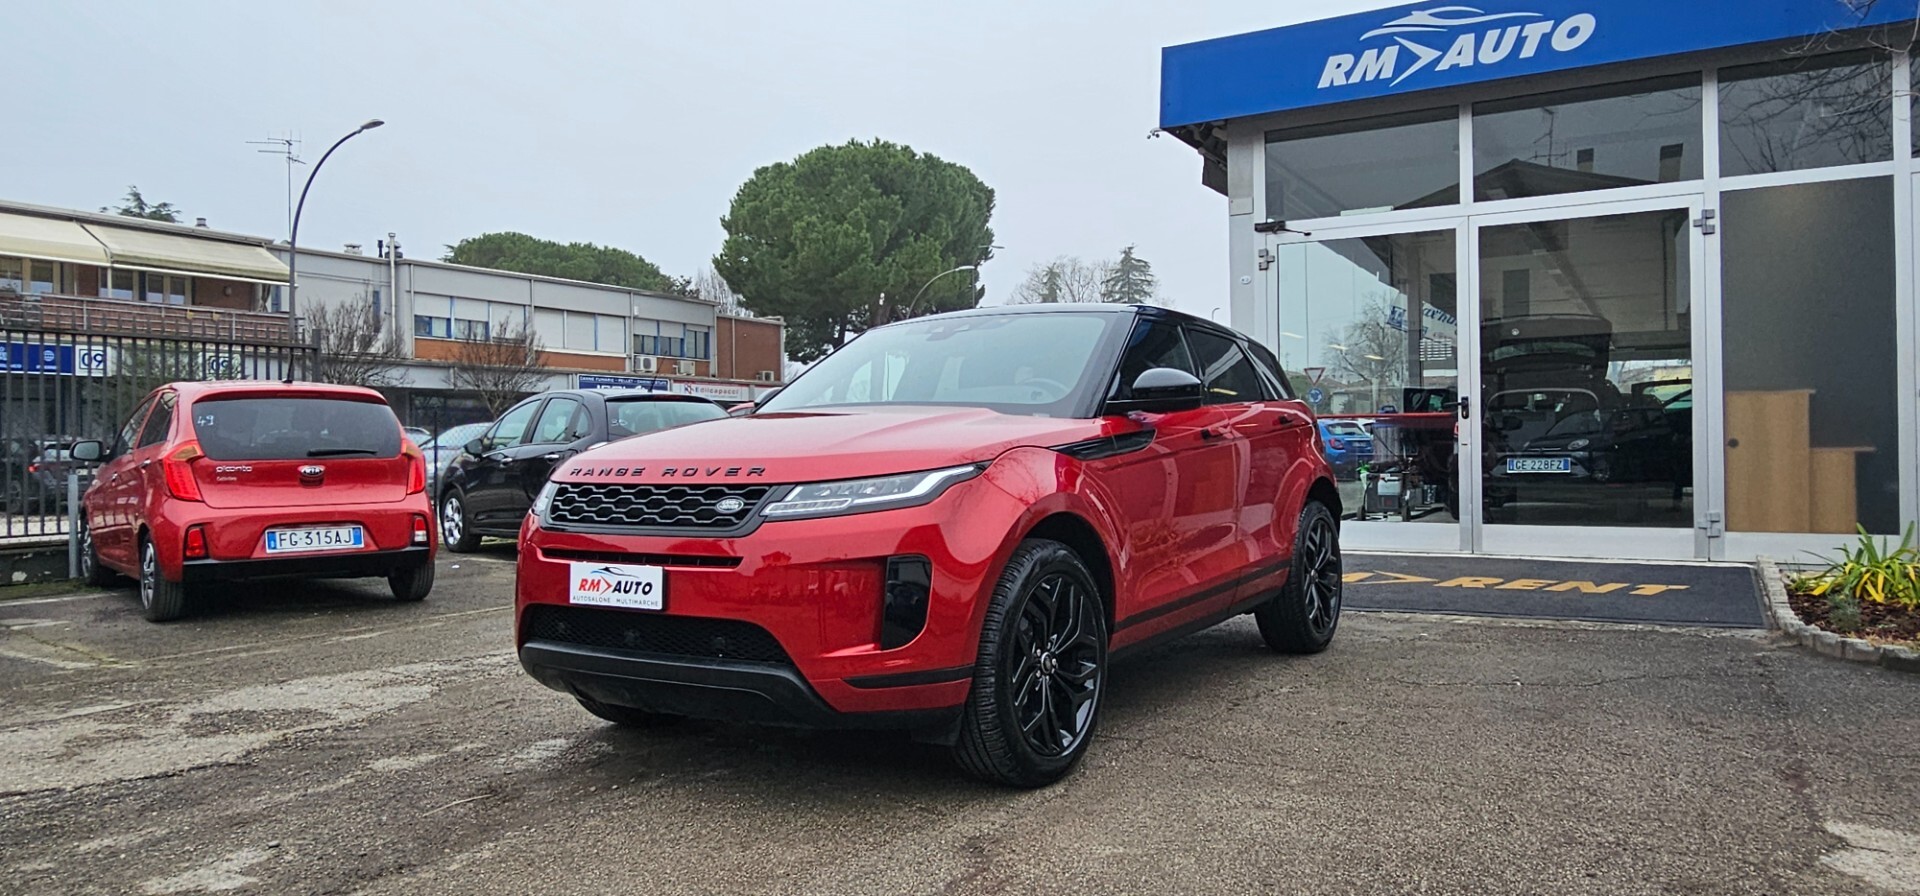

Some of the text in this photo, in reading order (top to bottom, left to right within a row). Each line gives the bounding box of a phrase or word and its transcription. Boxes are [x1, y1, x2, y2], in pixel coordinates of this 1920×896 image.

[1317, 12, 1596, 89] RM AUTO
[570, 466, 766, 478] RANGE ROVER
[278, 529, 352, 548] FG 315AJ
[578, 578, 653, 596] RM AUTO
[1433, 576, 1691, 596] RENT
[572, 595, 659, 607] AUTOSALONE MULTIMARCHE
